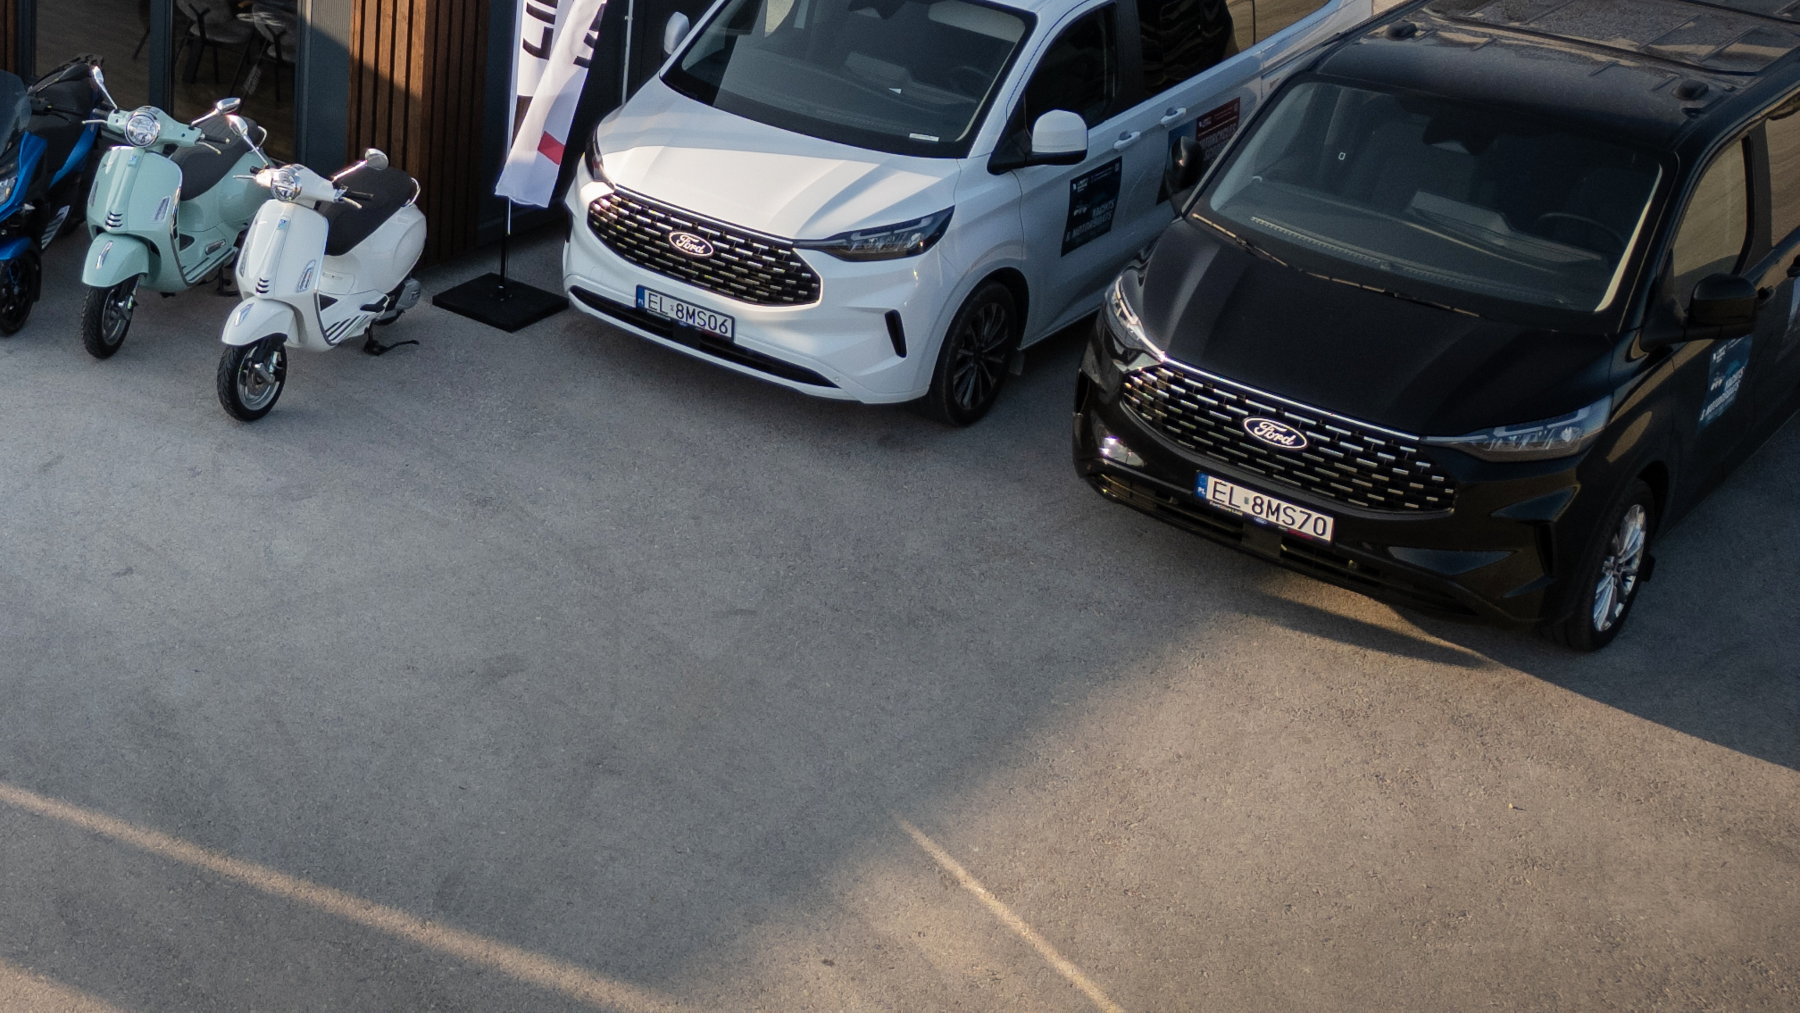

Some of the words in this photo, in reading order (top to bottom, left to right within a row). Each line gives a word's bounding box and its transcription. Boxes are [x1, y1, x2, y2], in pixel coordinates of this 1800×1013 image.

[676, 234, 706, 254] Ford
[647, 292, 668, 315] EL
[675, 302, 729, 335] 8MS06
[1254, 421, 1296, 445] Ford
[1212, 480, 1241, 509] EL
[1251, 495, 1327, 536] 8MS70
